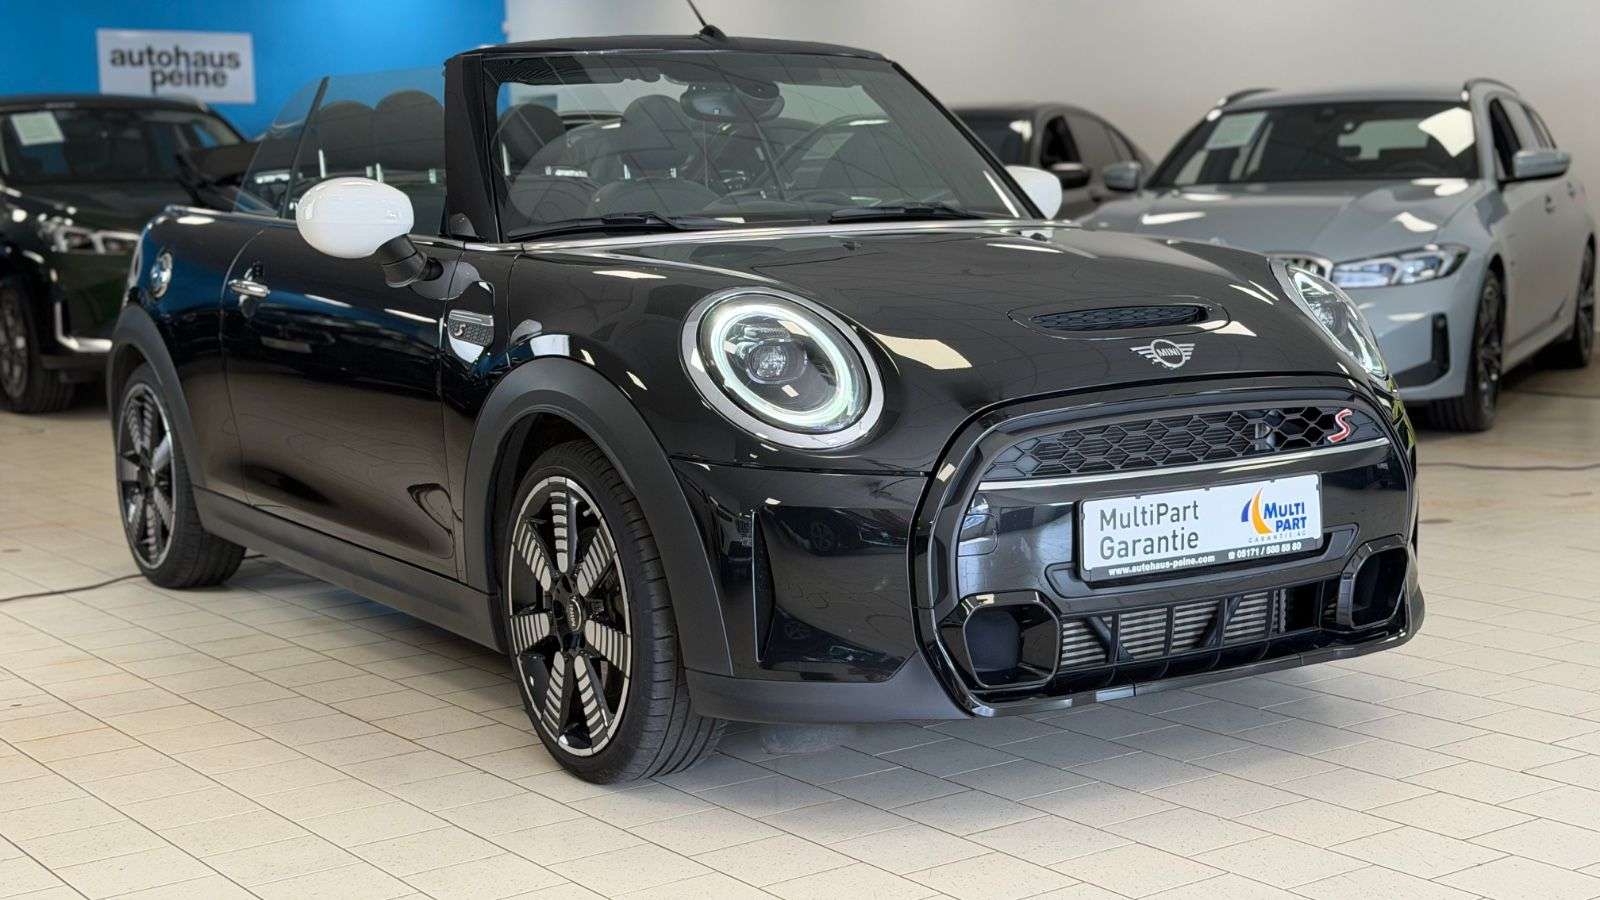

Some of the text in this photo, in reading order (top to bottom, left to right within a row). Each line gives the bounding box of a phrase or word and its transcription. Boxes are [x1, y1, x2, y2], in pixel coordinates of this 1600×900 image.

[110, 44, 241, 68] autohaus
[151, 68, 227, 94] peine
[1156, 348, 1181, 357] MINI
[1327, 408, 1353, 443] S
[1100, 500, 1199, 531] MultiPart
[1275, 516, 1307, 532] PART
[1100, 527, 1199, 560] Garantie
[1236, 547, 1260, 558] 05171
[1108, 555, 1216, 576] www.autohaus-peine.com
